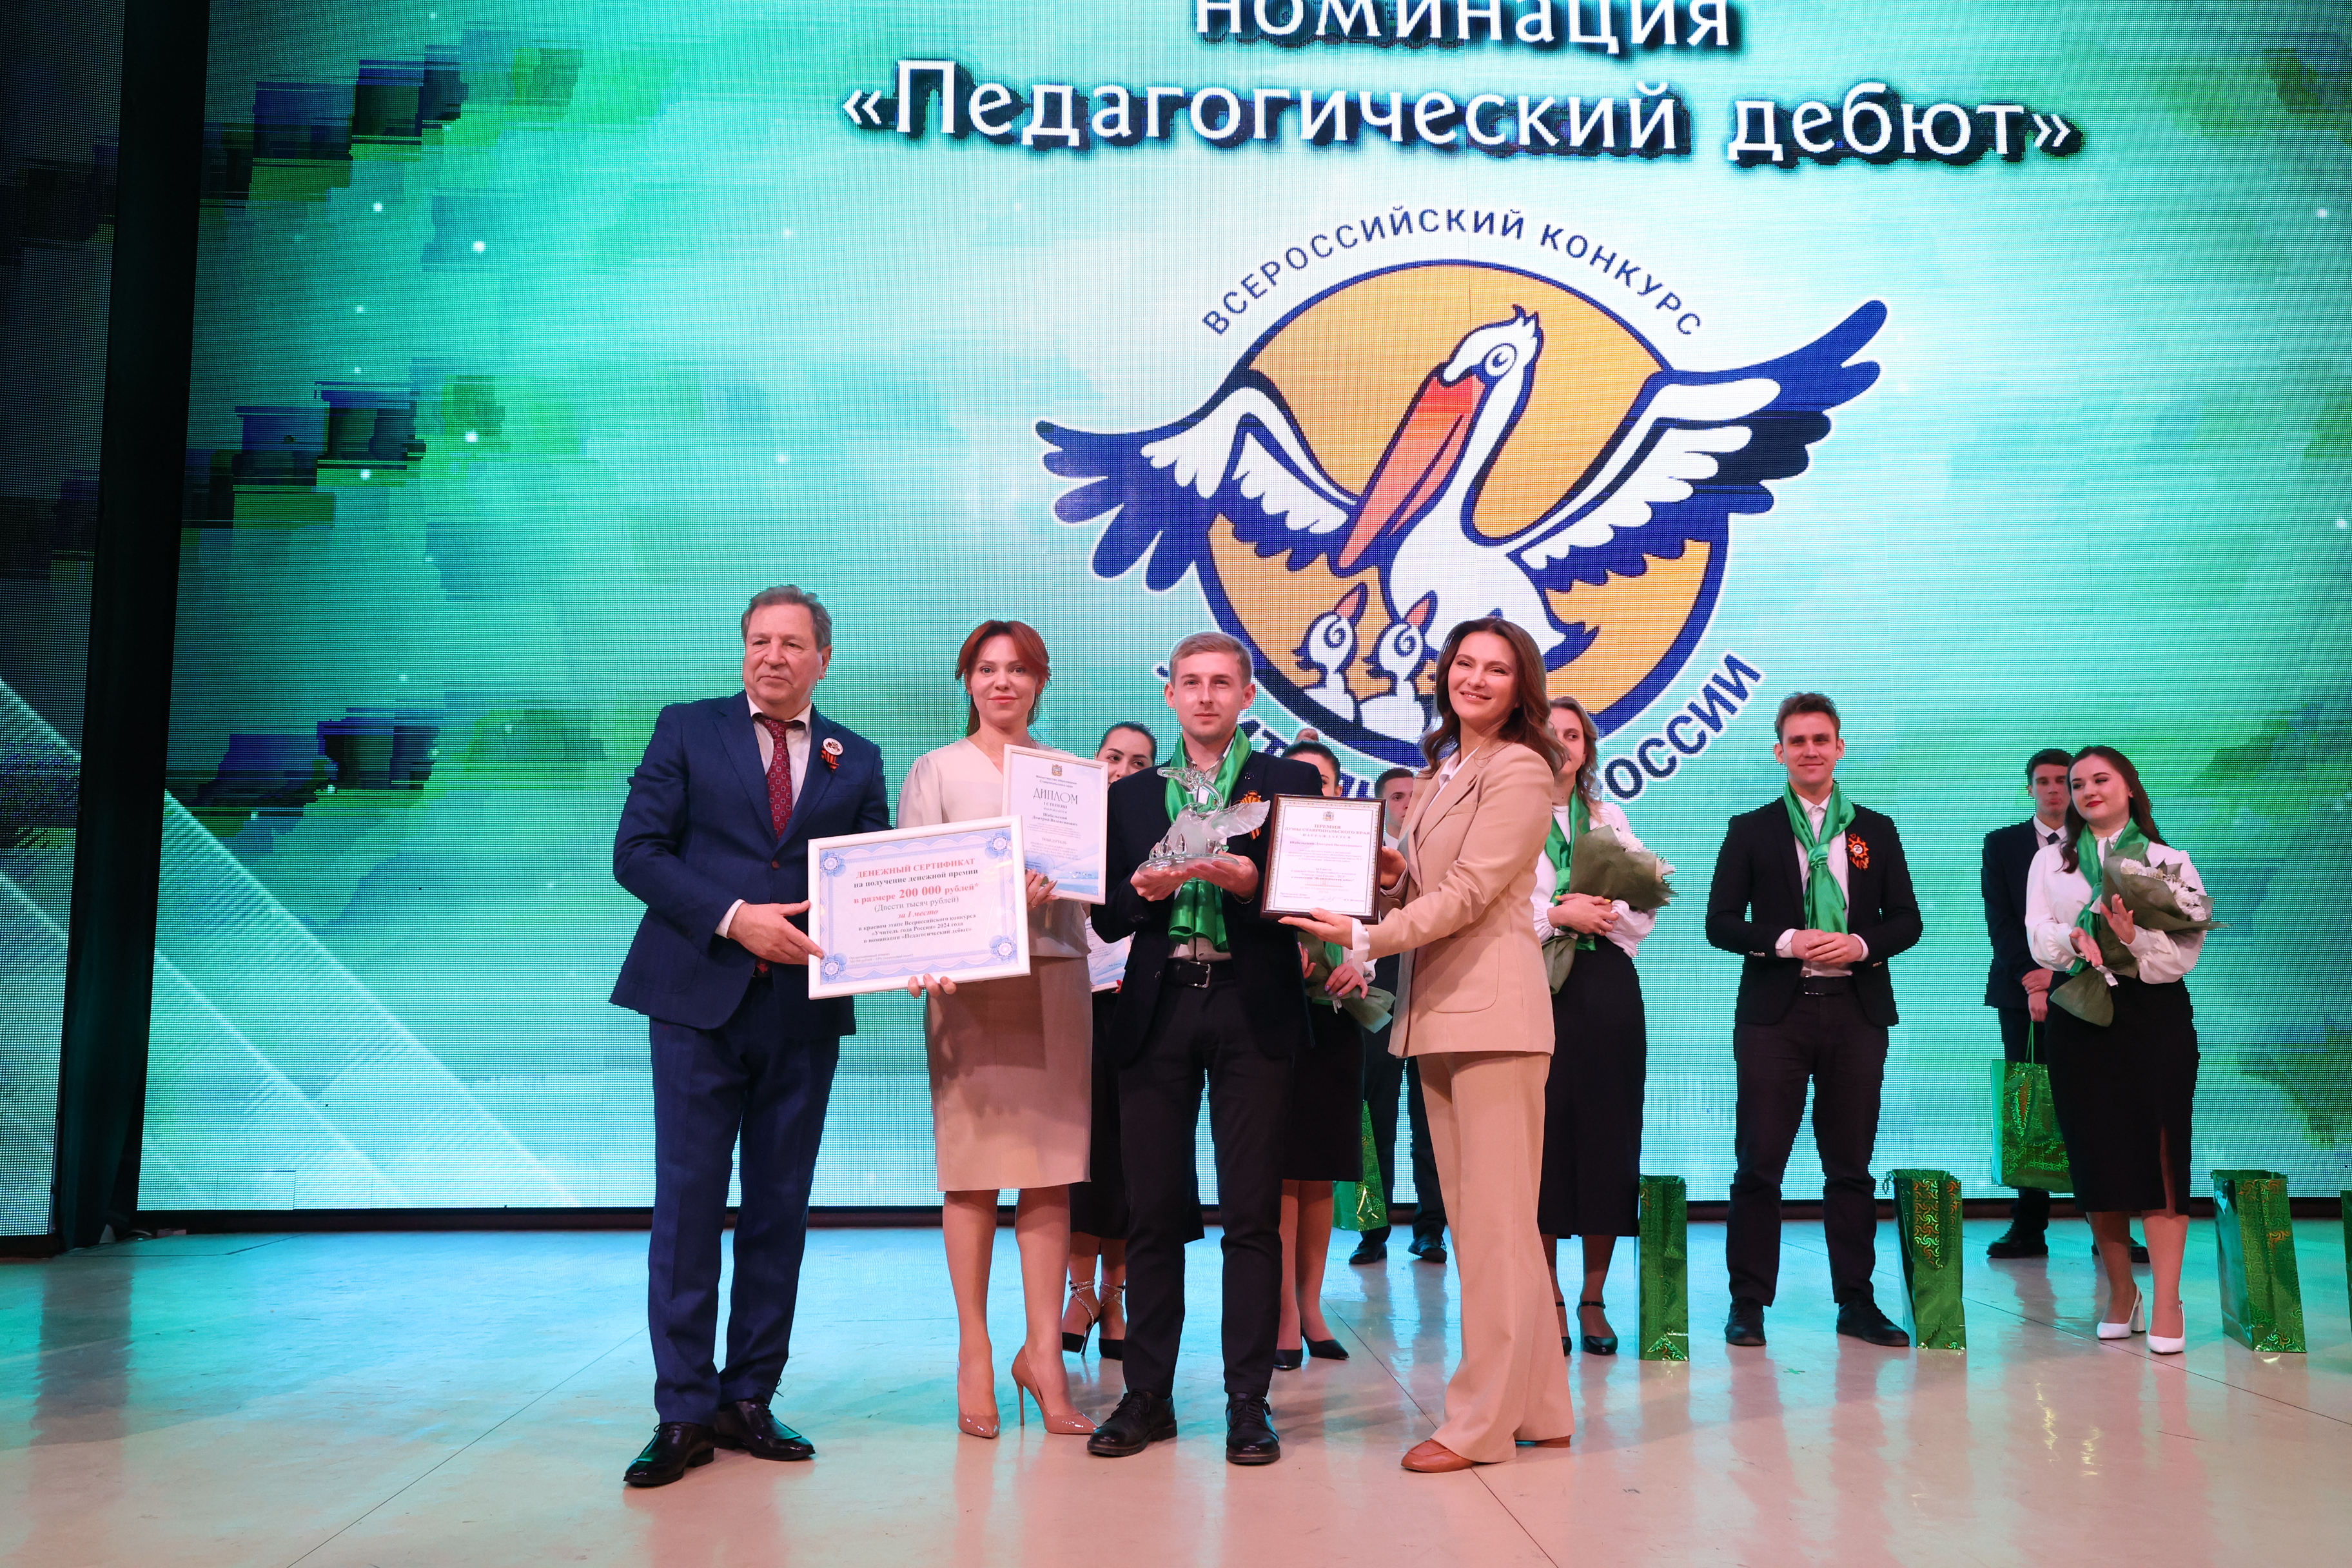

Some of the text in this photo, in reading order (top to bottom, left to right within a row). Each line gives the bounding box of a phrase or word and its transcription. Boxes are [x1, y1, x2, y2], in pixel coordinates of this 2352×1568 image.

[1197, 0, 1729, 54] номинация
[843, 60, 2071, 161] «Педагогический дебют»
[1202, 205, 1701, 336] ВСЕРОССИЙСКИЙ КОНКУРС
[1604, 653, 1762, 799] ОССИИ
[1033, 787, 1078, 805] ДИПЛОМ
[856, 858, 975, 879] ДЕНЕЖНЫЙ СЕРТИФИКАТ
[865, 877, 906, 887] получение
[908, 872, 946, 883] денежной
[948, 869, 979, 878] премии
[861, 894, 896, 906] размере
[899, 887, 918, 899] 200
[922, 885, 941, 896] 000
[874, 903, 904, 912] (Двести
[930, 896, 959, 906] рублей)
[863, 923, 887, 932] краевом
[905, 917, 949, 926] Всероссийского
[950, 914, 976, 922] конкурса
[901, 929, 950, 939] «Педагогический
